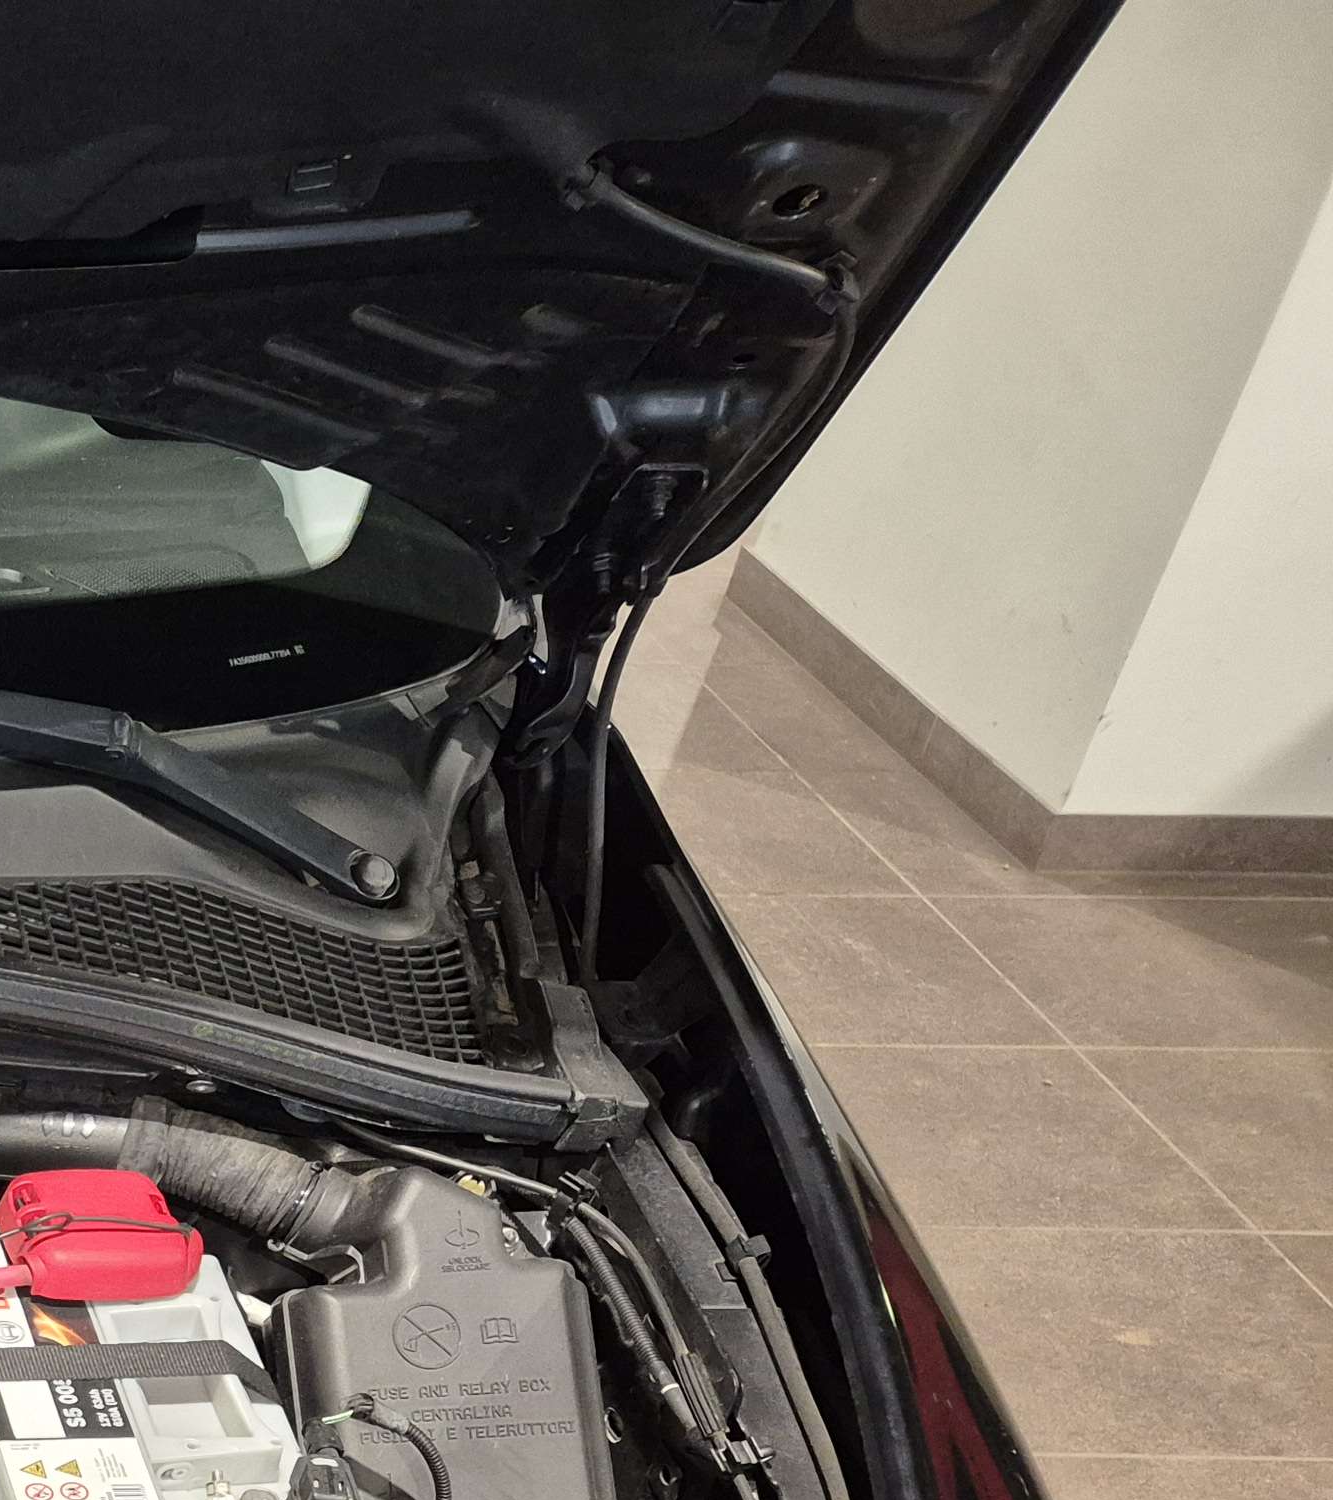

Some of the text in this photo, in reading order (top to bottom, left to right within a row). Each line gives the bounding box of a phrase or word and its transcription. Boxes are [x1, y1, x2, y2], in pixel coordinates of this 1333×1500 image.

[367, 1377, 552, 1400] FUSE AND RELAY BOX
[63, 1407, 88, 1429] S5
[410, 1404, 514, 1424] CENTRALINA
[446, 1426, 459, 1441] E
[464, 1420, 577, 1441] TELERUTTORI
